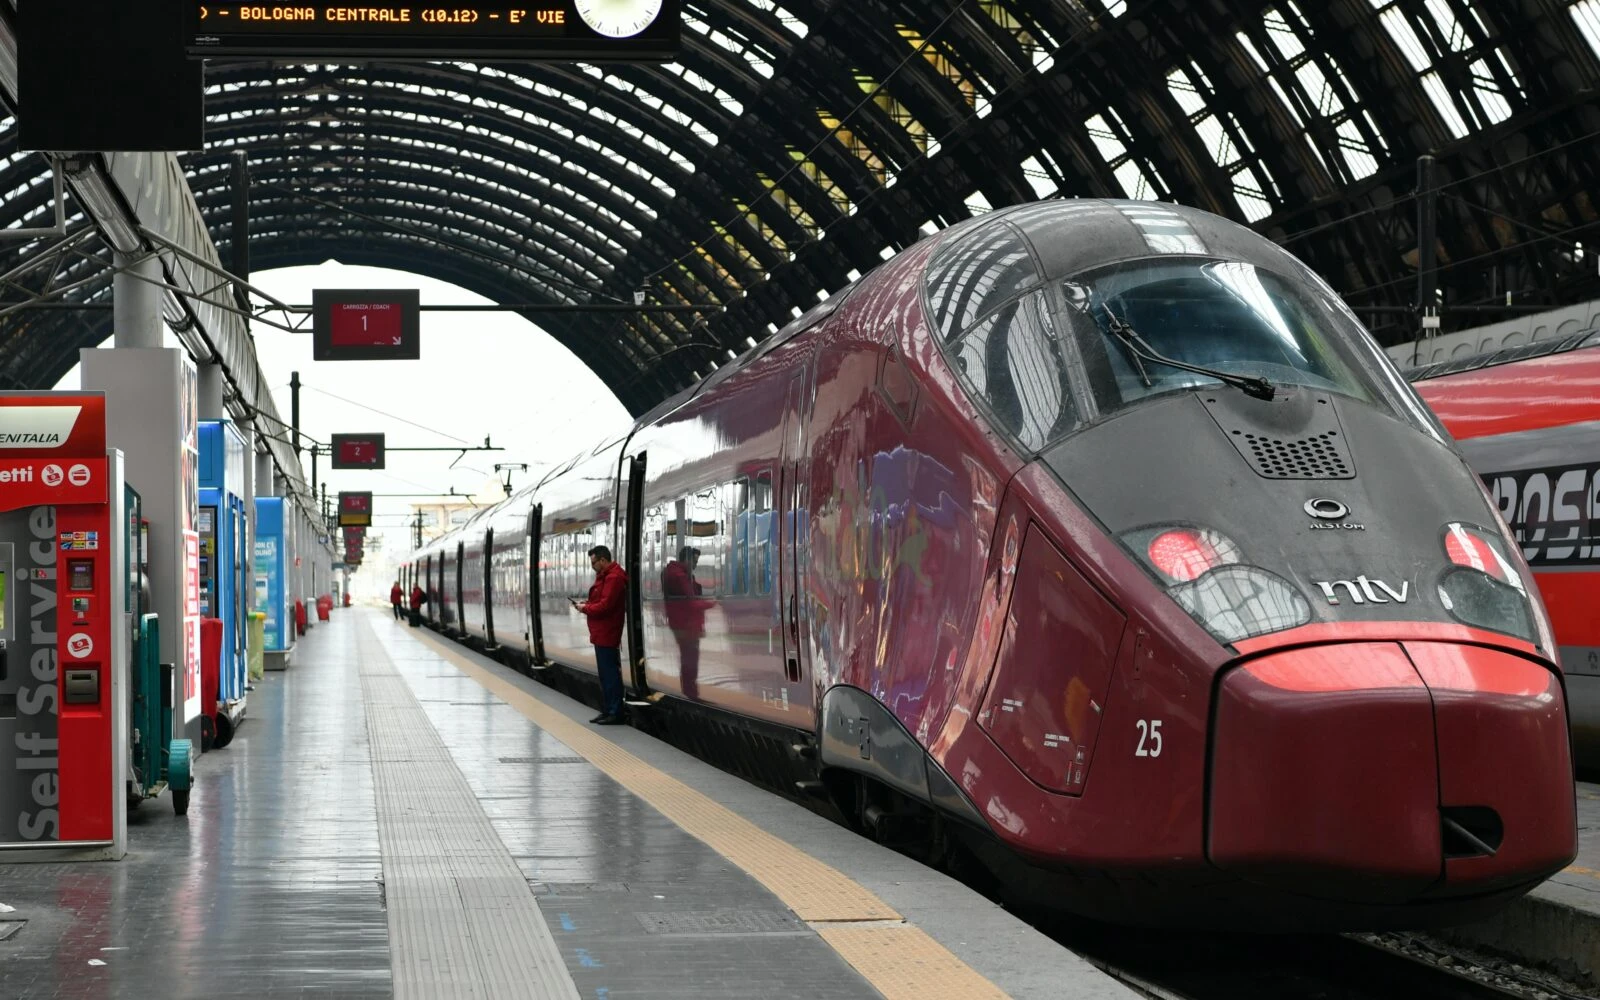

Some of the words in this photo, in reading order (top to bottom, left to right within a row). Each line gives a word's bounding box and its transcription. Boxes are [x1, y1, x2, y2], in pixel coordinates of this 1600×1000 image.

[240, 7, 315, 20] BOLOGNA
[326, 8, 410, 22] CENTRALE
[421, 9, 479, 23] (10.12)
[537, 10, 565, 24] VIE
[361, 314, 368, 332] 1
[355, 446, 361, 456] 2
[0, 465, 33, 483] etti
[1309, 522, 1365, 531] ALSTOM
[1312, 575, 1409, 606] ntv
[15, 505, 58, 715] Service
[1135, 719, 1162, 757] 25
[15, 732, 59, 840] Self
